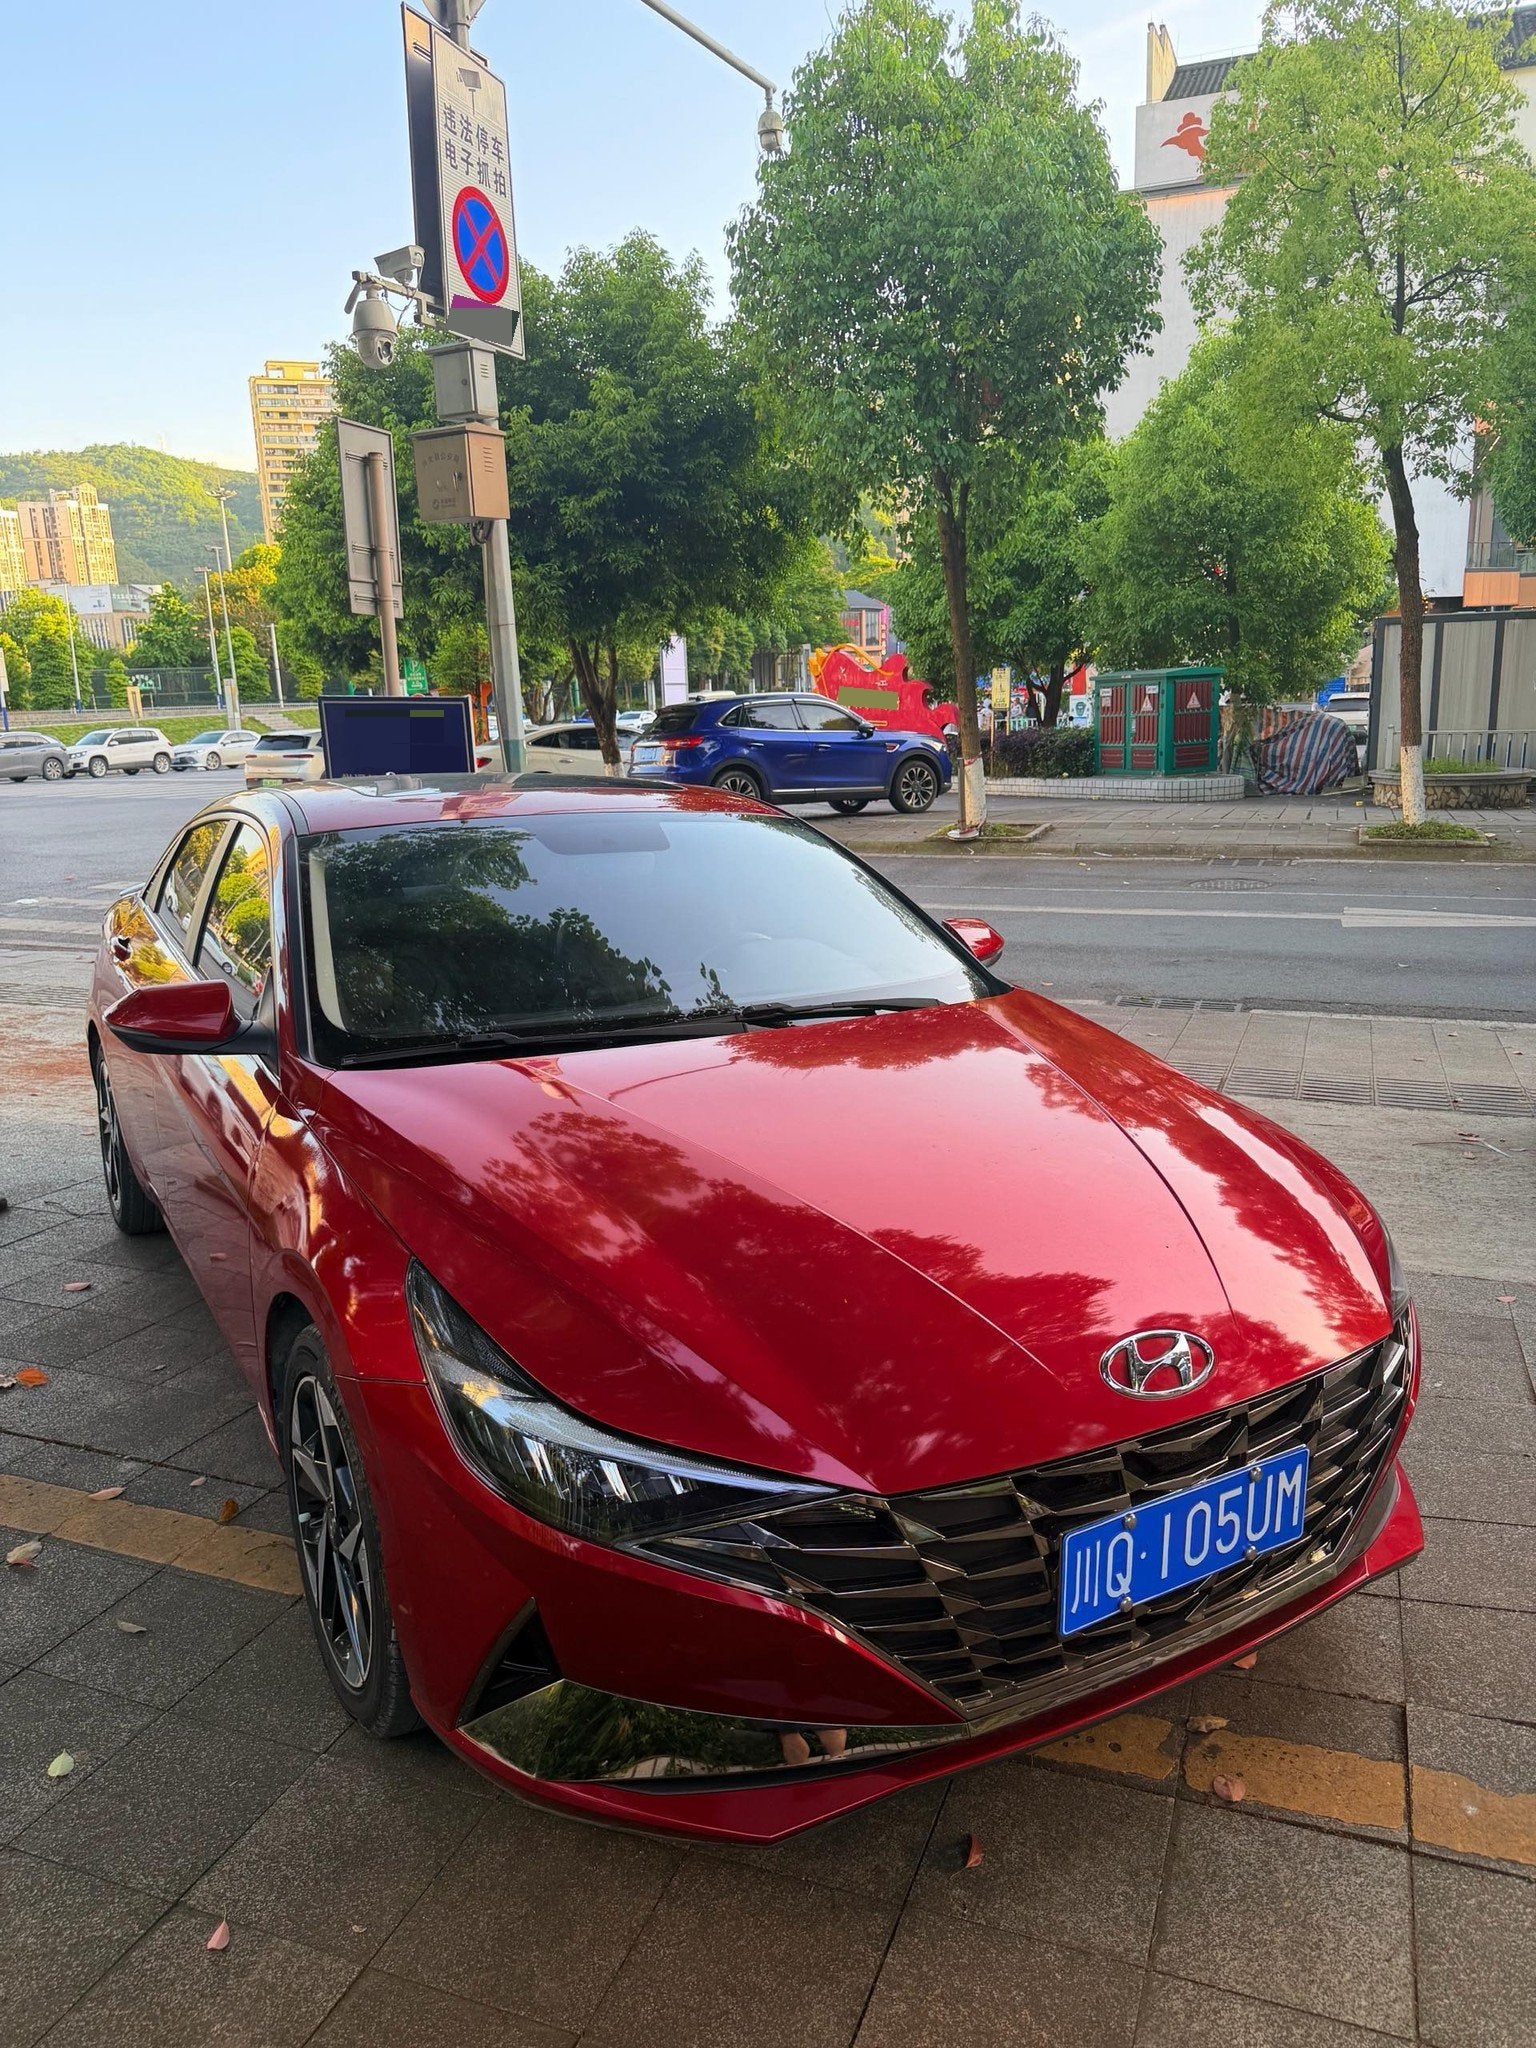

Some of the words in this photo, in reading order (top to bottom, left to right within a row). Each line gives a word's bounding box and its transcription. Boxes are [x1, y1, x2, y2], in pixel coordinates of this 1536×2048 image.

[443, 102, 504, 164] 违法停车
[445, 138, 506, 198] 电子抓拍
[1071, 1464, 1303, 1614] 川Q·105UM
